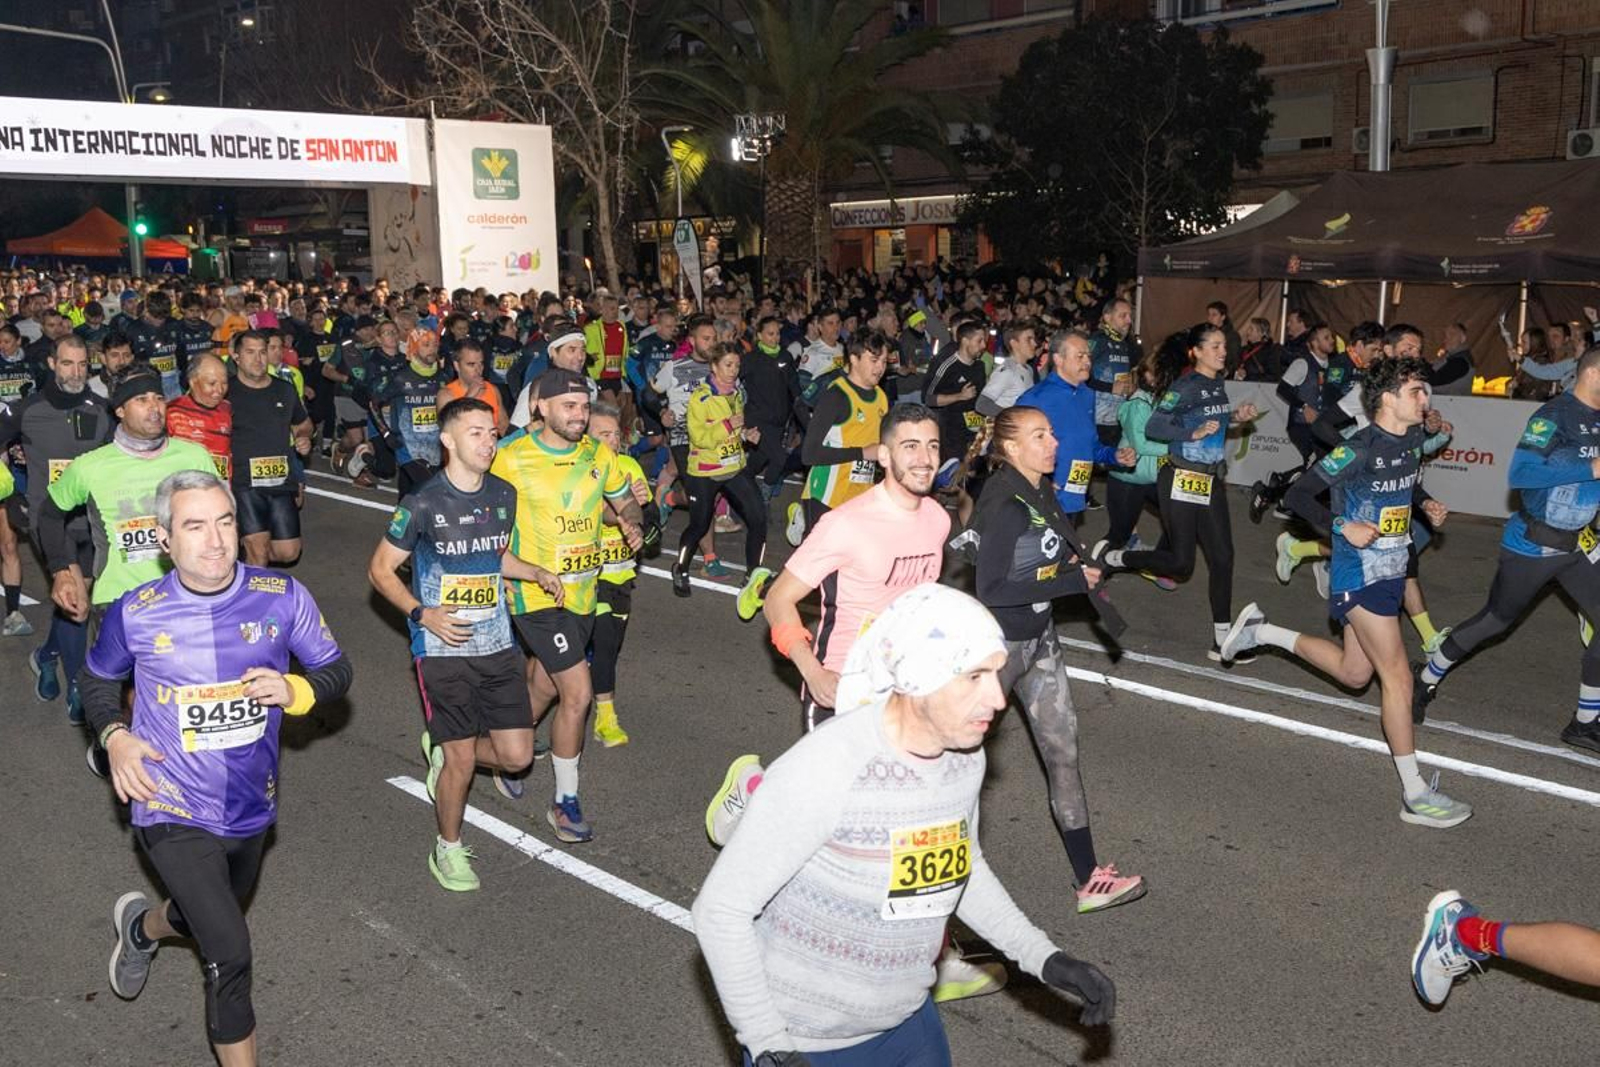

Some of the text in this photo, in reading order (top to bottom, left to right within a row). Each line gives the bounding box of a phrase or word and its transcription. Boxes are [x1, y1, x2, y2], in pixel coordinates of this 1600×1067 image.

[30, 127, 206, 157] INTERNACIONAL
[211, 134, 273, 160] NOCHE
[277, 136, 301, 161] DE
[305, 138, 341, 162] SAN
[342, 139, 398, 163] ANTON
[467, 213, 528, 224] calderón
[832, 206, 906, 226] CONFECCIONS
[404, 395, 422, 404] SAN
[1431, 447, 1494, 465] erón
[255, 464, 286, 476] 3382
[1072, 468, 1089, 482] 36
[1178, 477, 1209, 493] 3133
[1371, 480, 1397, 493] SAN
[554, 514, 593, 535] Jaén
[435, 539, 468, 556] SAN
[602, 547, 629, 561] 318
[562, 553, 600, 571] 3135
[446, 587, 494, 604] 4460
[554, 632, 569, 654] 9
[199, 687, 216, 699] 42
[187, 698, 262, 726] 9458
[912, 831, 929, 847] 42
[899, 844, 967, 886] 3628
